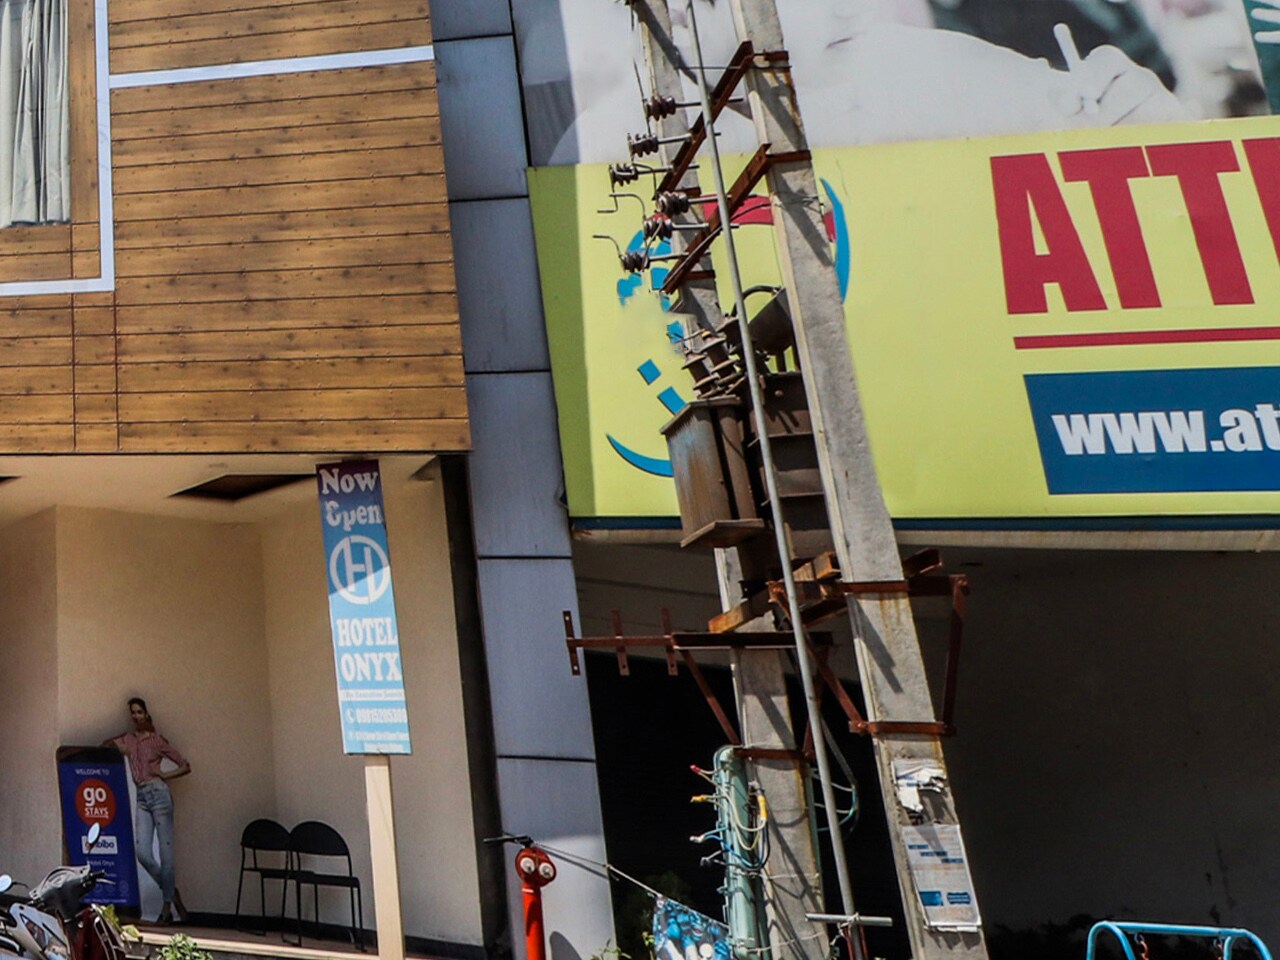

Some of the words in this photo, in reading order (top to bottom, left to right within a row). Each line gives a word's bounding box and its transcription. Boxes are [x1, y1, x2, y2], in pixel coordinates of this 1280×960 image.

[321, 467, 380, 495] Now
[336, 617, 398, 647] HOTEL
[341, 651, 403, 682] ONYX
[83, 787, 107, 807] go
[85, 807, 109, 816] STAYS
